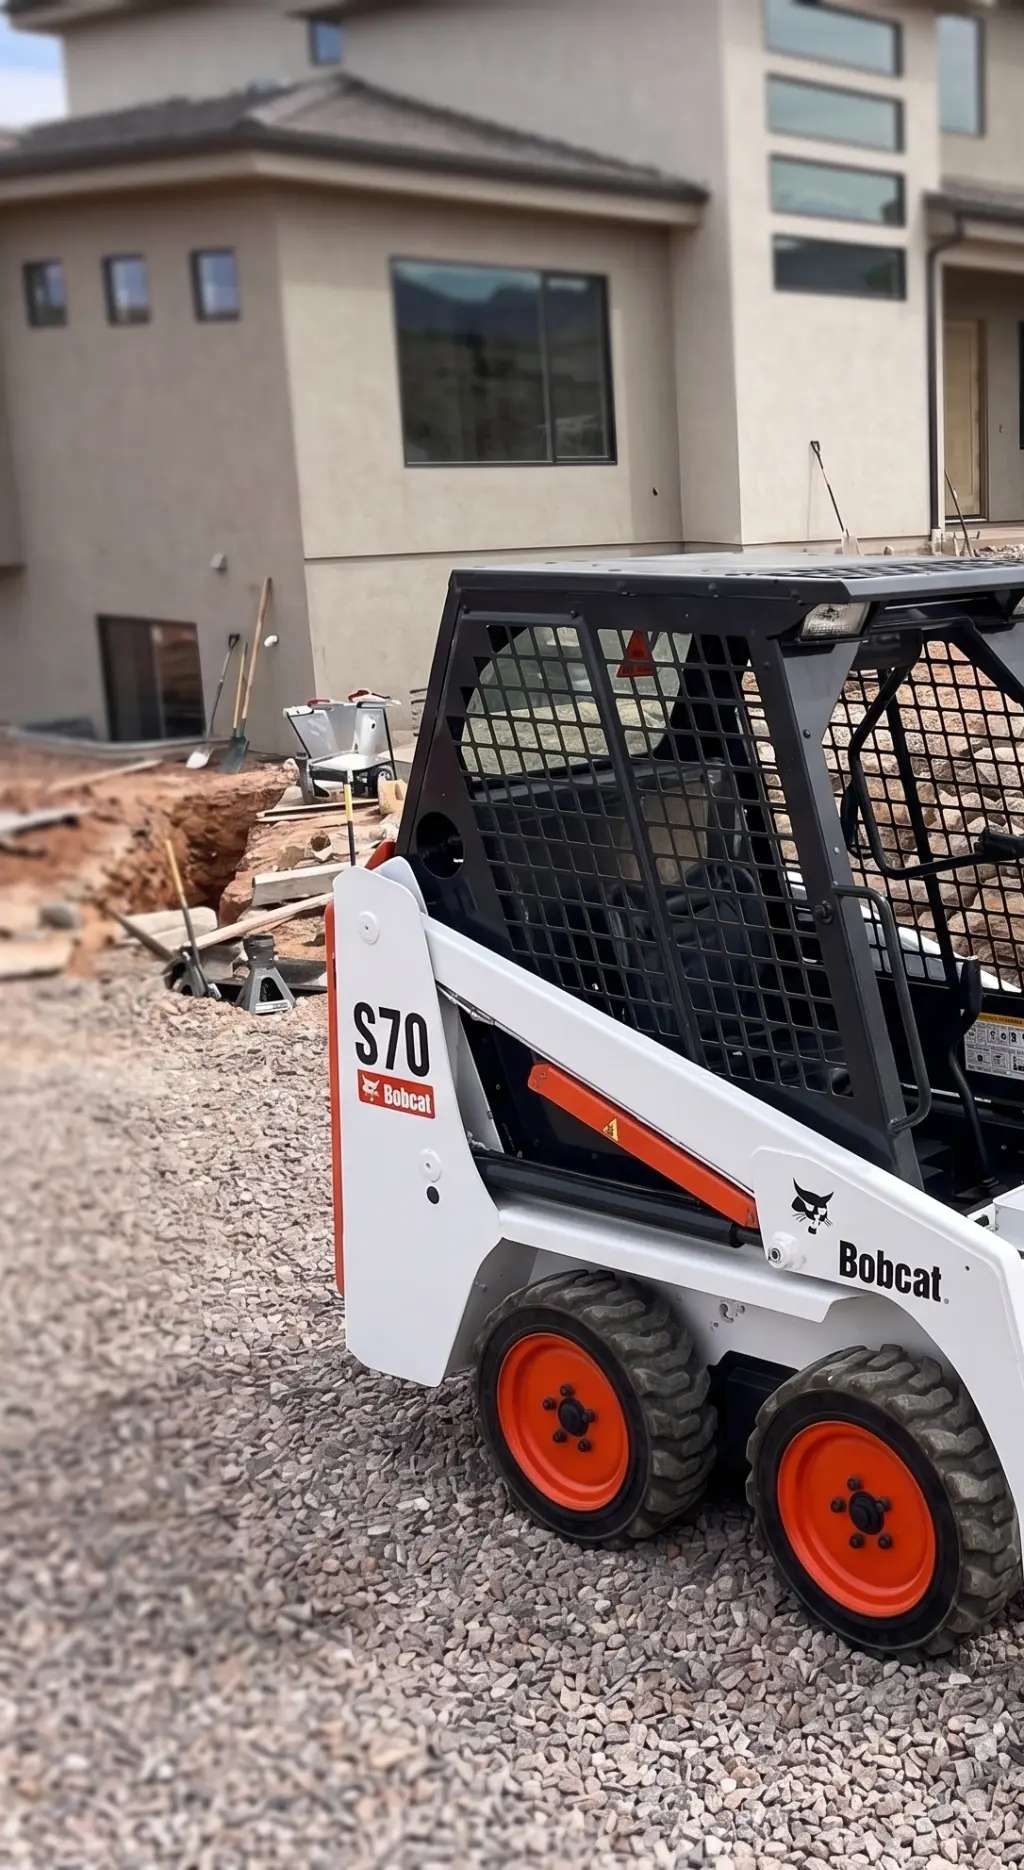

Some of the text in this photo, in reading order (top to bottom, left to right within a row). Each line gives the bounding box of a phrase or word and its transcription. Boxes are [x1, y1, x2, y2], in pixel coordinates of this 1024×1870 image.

[353, 1001, 430, 1077] S70
[383, 1083, 432, 1114] Bobcat
[839, 1239, 942, 1302] Bobcat
